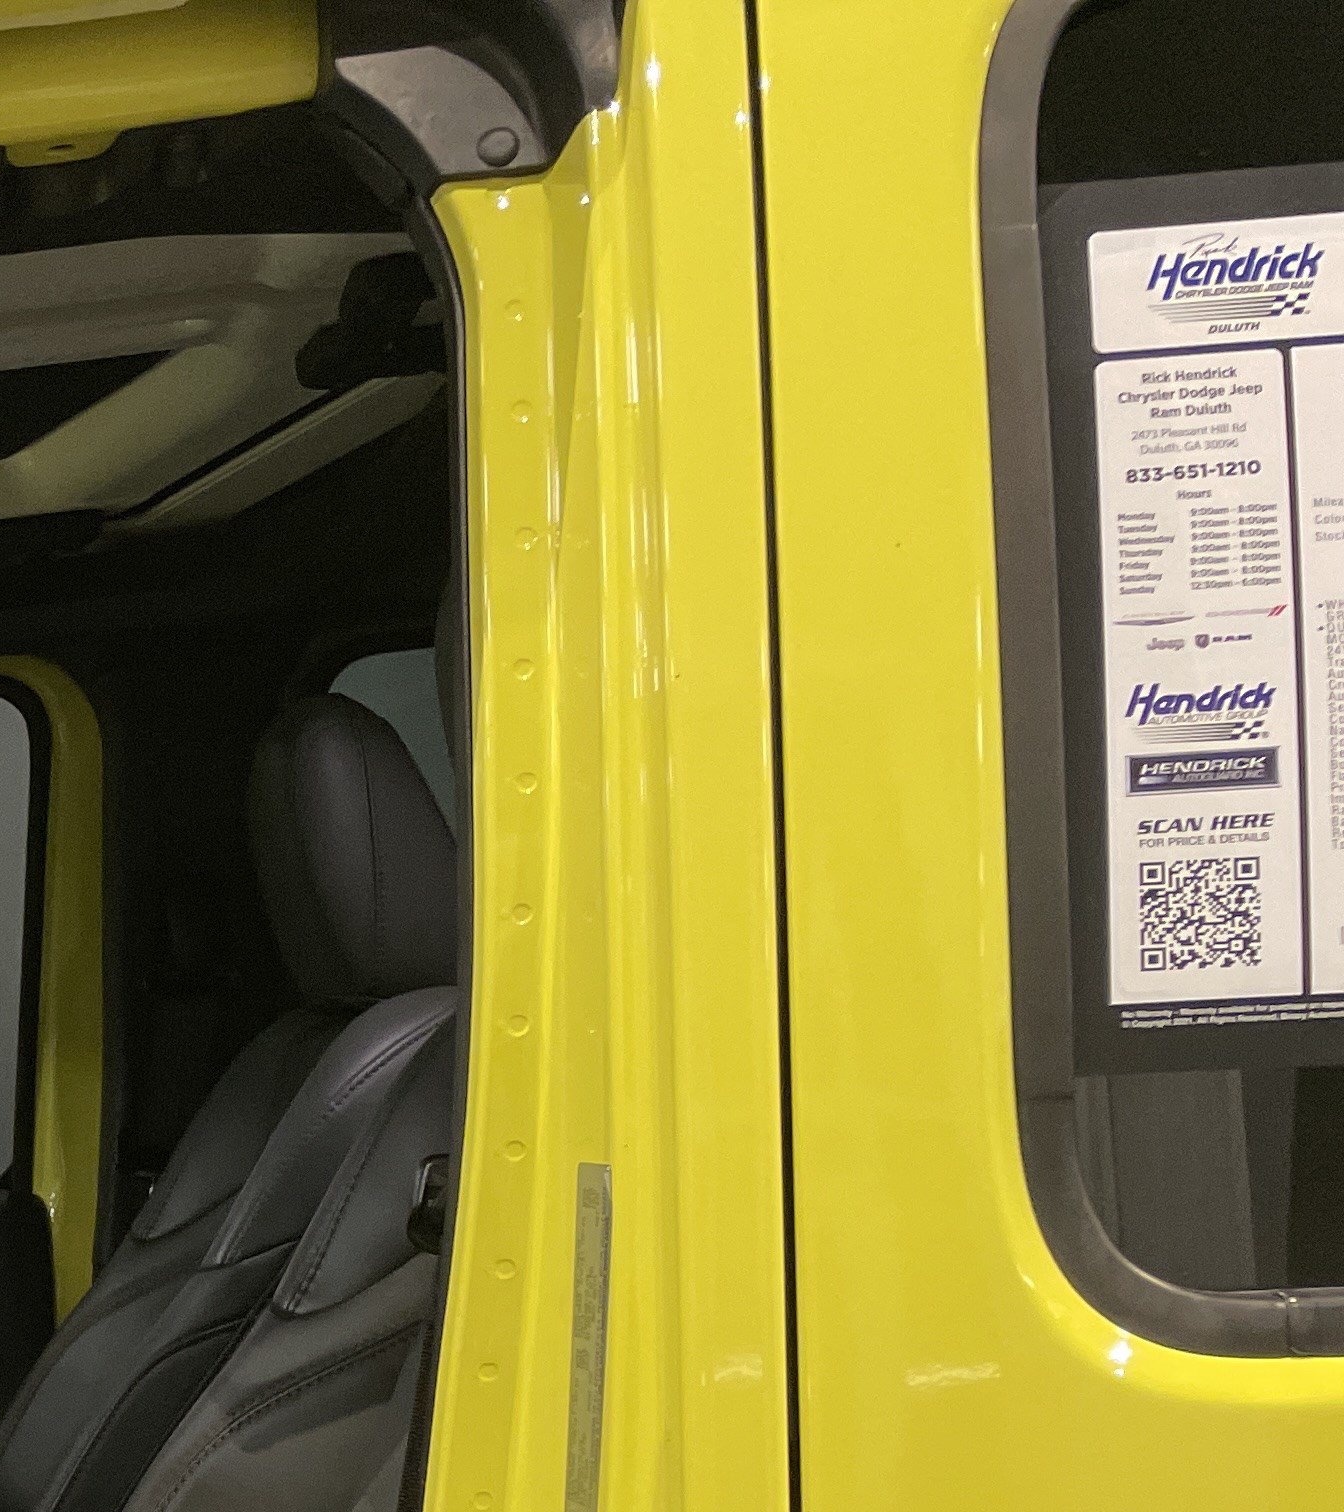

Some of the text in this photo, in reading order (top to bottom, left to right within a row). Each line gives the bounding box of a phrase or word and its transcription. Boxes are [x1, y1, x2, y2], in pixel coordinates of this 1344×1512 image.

[1146, 242, 1325, 301] Hendrick
[1208, 321, 1260, 334] DULUTH
[1141, 366, 1237, 384] Rick Hendrick
[1118, 382, 1263, 404] Chrysler Dodge Jeep
[1150, 402, 1232, 418] Ram Duluth
[1126, 459, 1261, 483] 833-651-1210
[1176, 489, 1212, 501] Hours
[1125, 681, 1278, 727] Hendrick
[1140, 756, 1267, 776] HENDRICK
[1137, 812, 1276, 836] SCAN HERE
[1139, 831, 1270, 849] FOR PRICE & DETAILS
